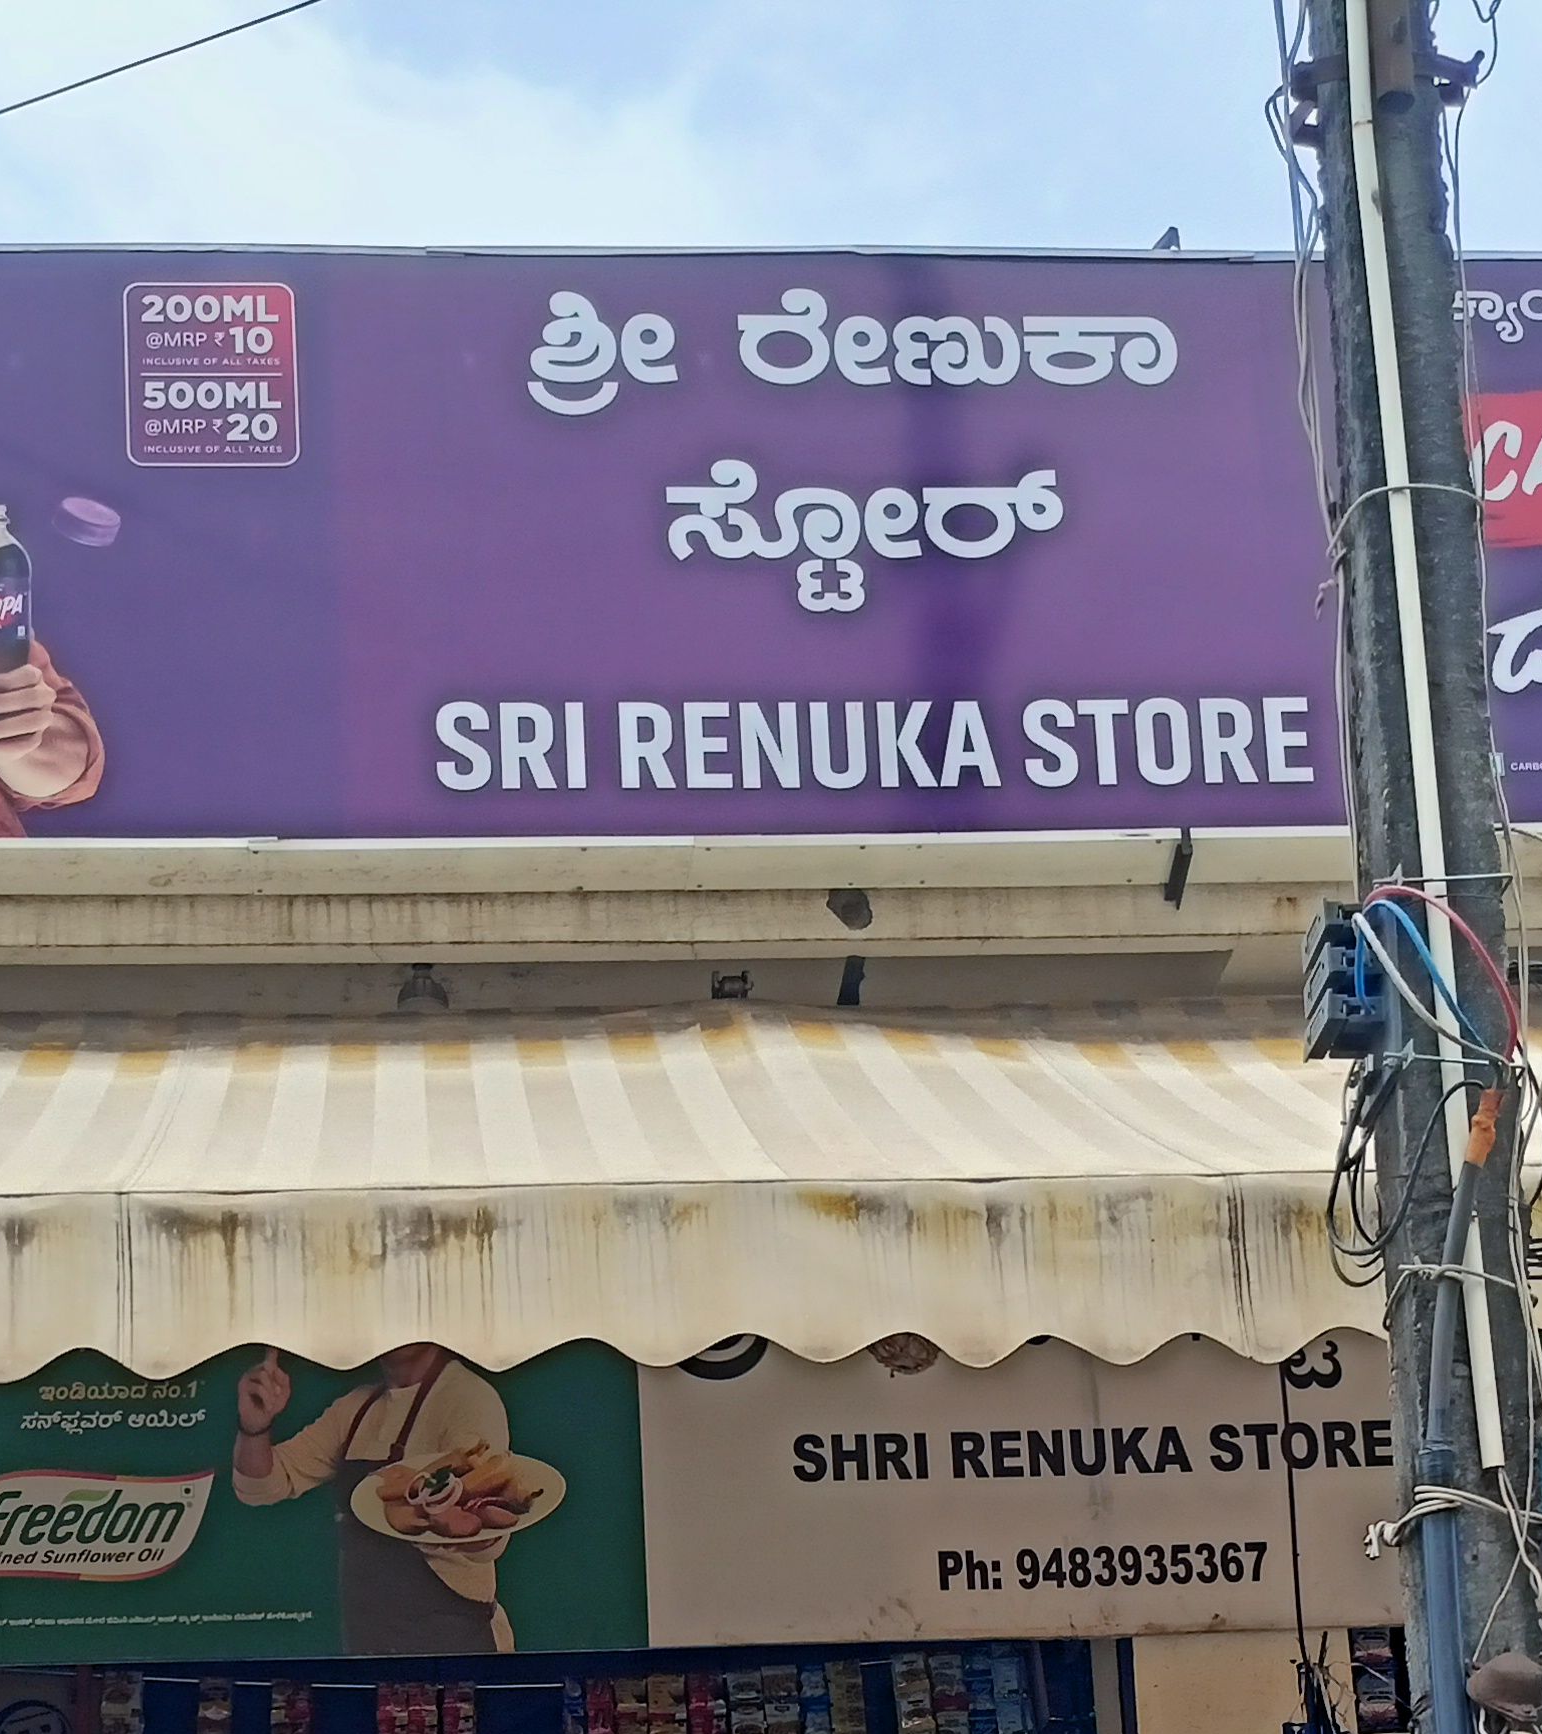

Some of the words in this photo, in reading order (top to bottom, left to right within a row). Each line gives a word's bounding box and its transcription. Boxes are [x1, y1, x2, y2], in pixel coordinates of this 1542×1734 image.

[140, 294, 280, 323] 200ML
[145, 331, 208, 349] @MRP
[526, 290, 680, 417] ಶ್ರೀ
[737, 287, 1178, 389] ರೇಣುಕಾ
[142, 357, 199, 366] INCLUSIVE
[203, 357, 218, 366] OF
[222, 357, 242, 366] ALL
[247, 357, 281, 366] TAXES
[142, 381, 282, 409] 500ML
[144, 418, 207, 436] @MRP
[144, 445, 200, 454] INCLUSIVE
[205, 445, 219, 454] OF
[223, 445, 244, 454] ALL
[248, 445, 282, 454] TAXES
[665, 458, 1064, 614] ಸ್ಟೋರ್
[433, 700, 586, 792] SRI
[618, 699, 1002, 791] RENUKA
[1021, 694, 1316, 787] STORE
[792, 1433, 930, 1483] SHRI
[951, 1424, 1192, 1479] RENUKA
[1209, 1419, 1394, 1471] STORE
[40, 1548, 134, 1565] Sunflower
[138, 1547, 165, 1562] Oil
[937, 1549, 1004, 1591] Ph:
[1015, 1542, 1268, 1590] 9483935367
